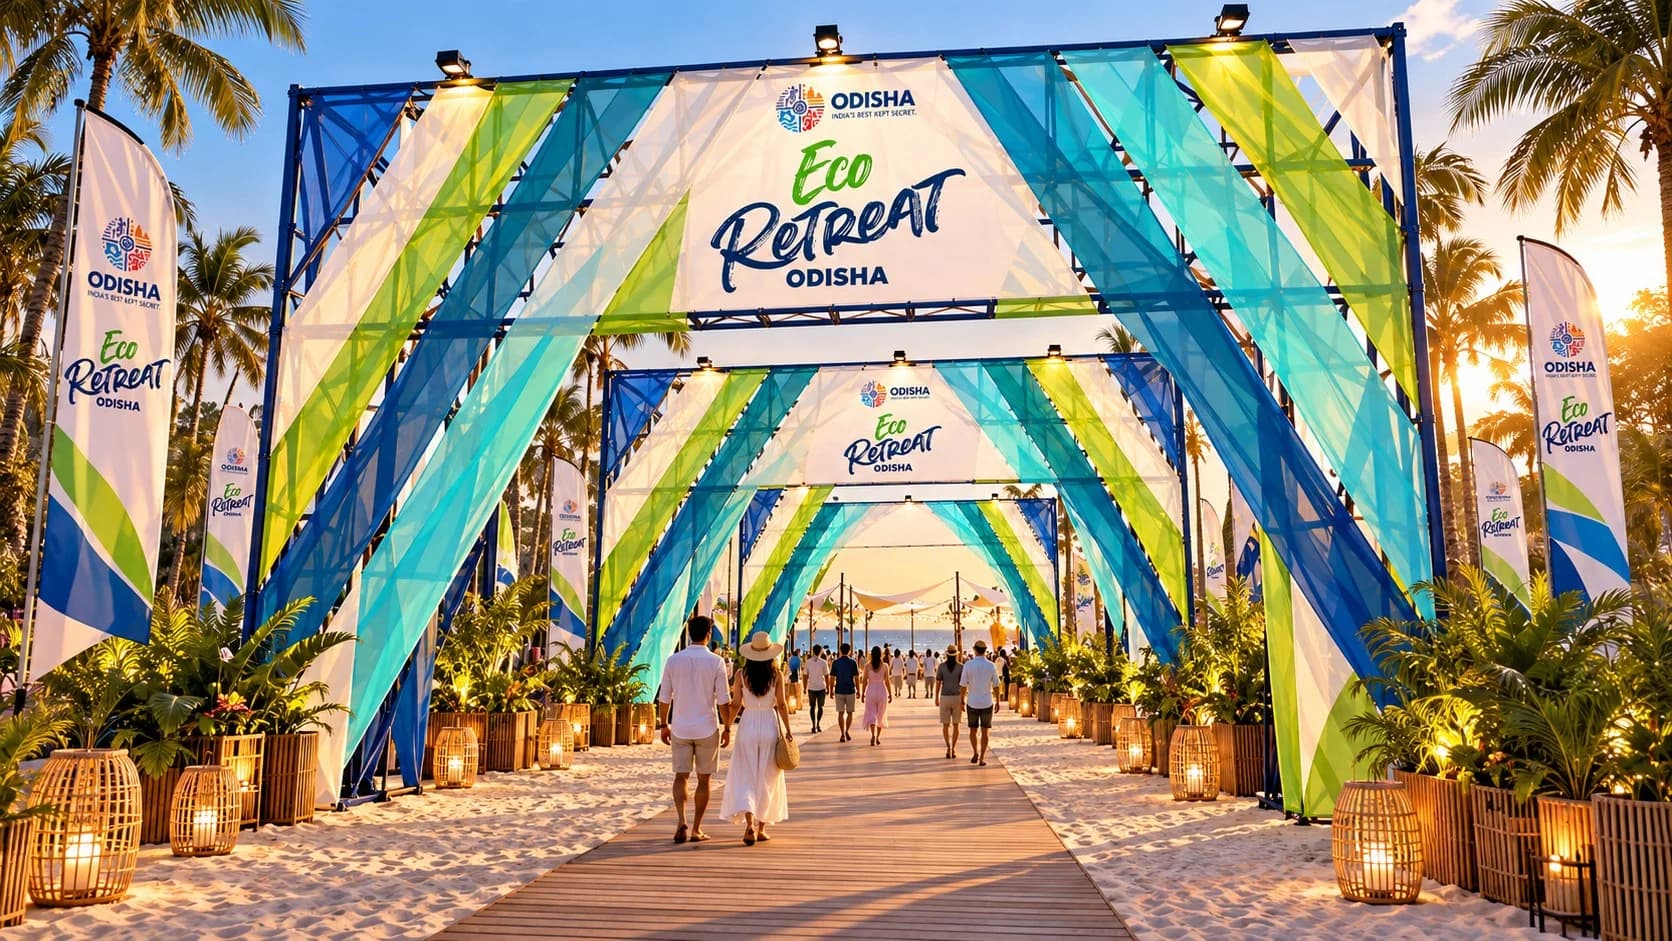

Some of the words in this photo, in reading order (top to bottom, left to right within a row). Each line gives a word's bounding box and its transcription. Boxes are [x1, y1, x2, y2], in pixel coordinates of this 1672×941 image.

[831, 89, 916, 110] ODISHA
[831, 112, 856, 120] INDIA'S
[891, 108, 918, 117] SECRET.
[791, 139, 873, 206] Eco
[87, 270, 161, 301] ODISHA
[786, 266, 888, 288] ODISHA
[100, 329, 139, 365] Eco
[1544, 361, 1596, 373] ODISHA
[890, 386, 931, 396] ODISHA
[96, 396, 140, 412] ODISHA
[1561, 395, 1588, 423] Eco
[874, 413, 907, 441] Eco
[1564, 444, 1596, 453] ODISHA
[873, 463, 913, 473] ODISHA
[224, 482, 241, 500] Eco
